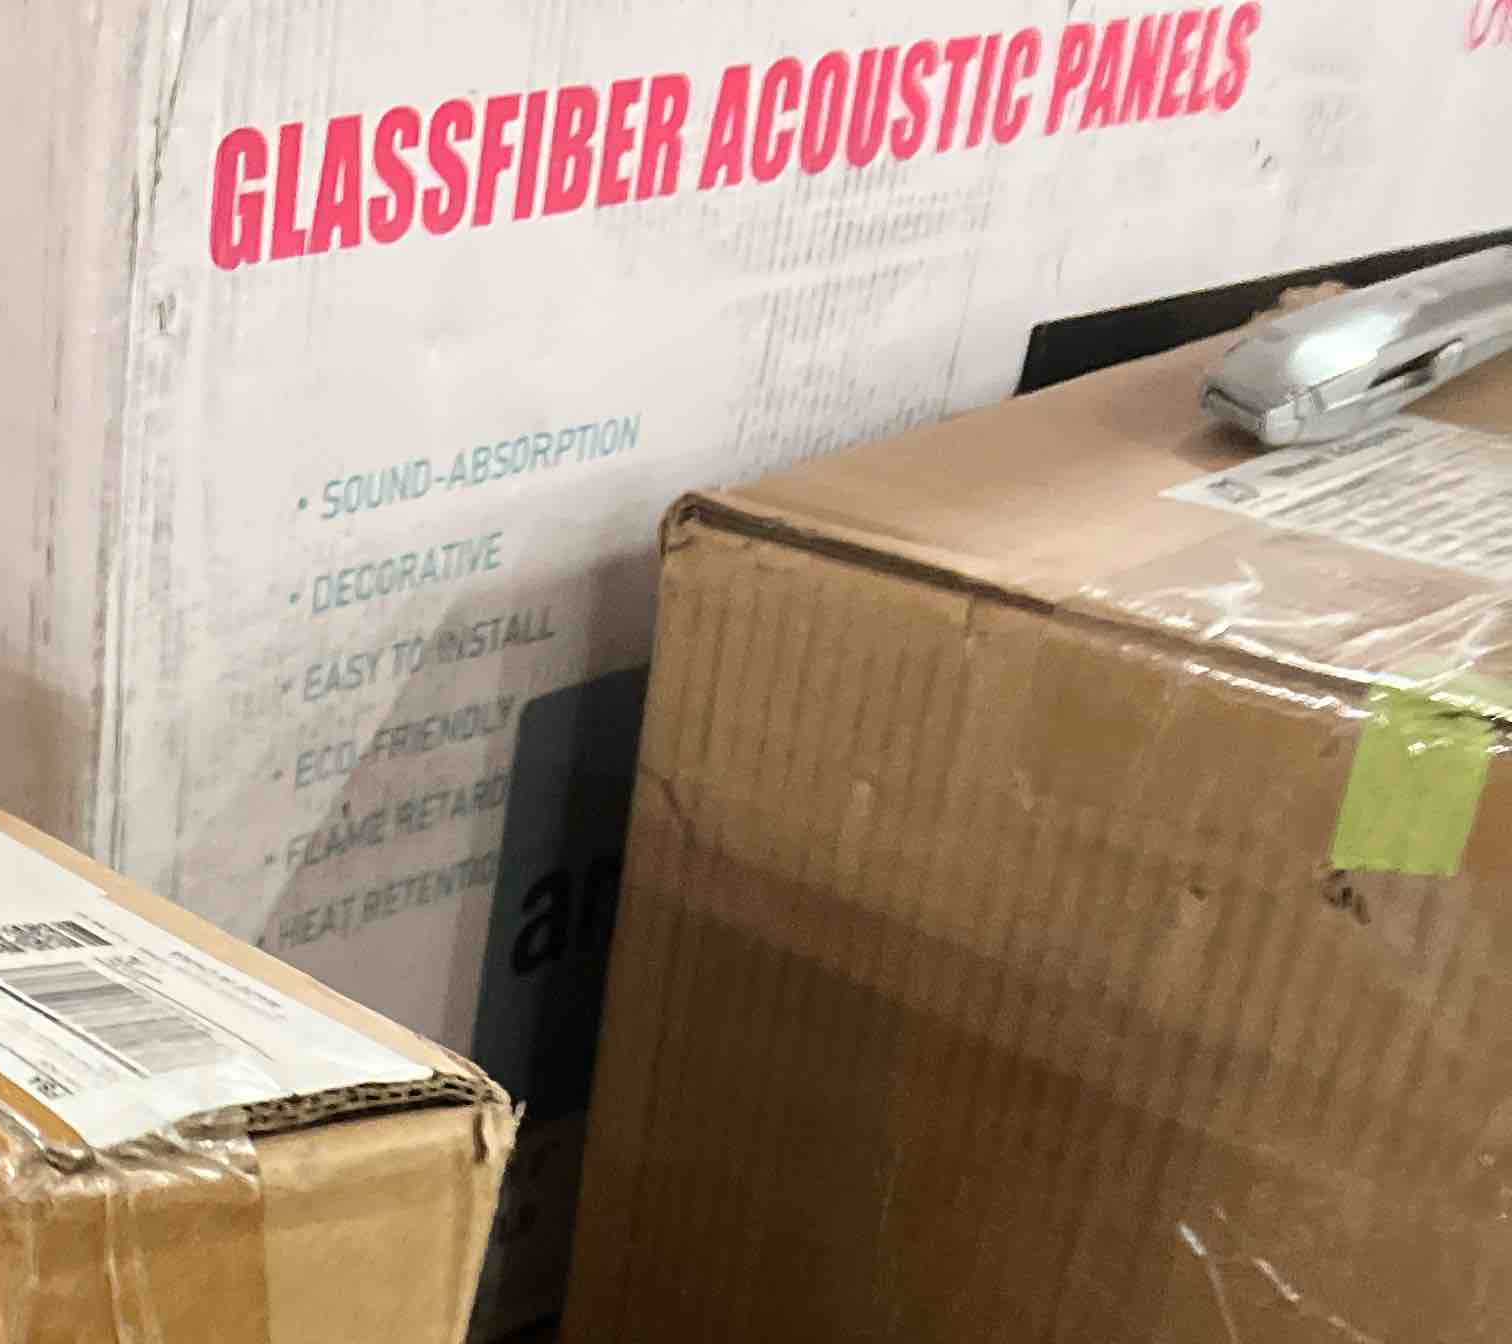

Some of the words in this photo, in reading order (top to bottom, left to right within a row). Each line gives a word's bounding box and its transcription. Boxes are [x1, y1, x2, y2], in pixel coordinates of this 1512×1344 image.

[209, 71, 690, 272] GLASSFIBER
[696, 23, 1042, 192] ACOUSTIC
[1043, 1, 1264, 138] PANELS
[321, 412, 642, 520] SOUND-ABSORPTION
[312, 530, 504, 615] DECORATIVE
[303, 652, 383, 702] EASY
[391, 638, 425, 674] TO
